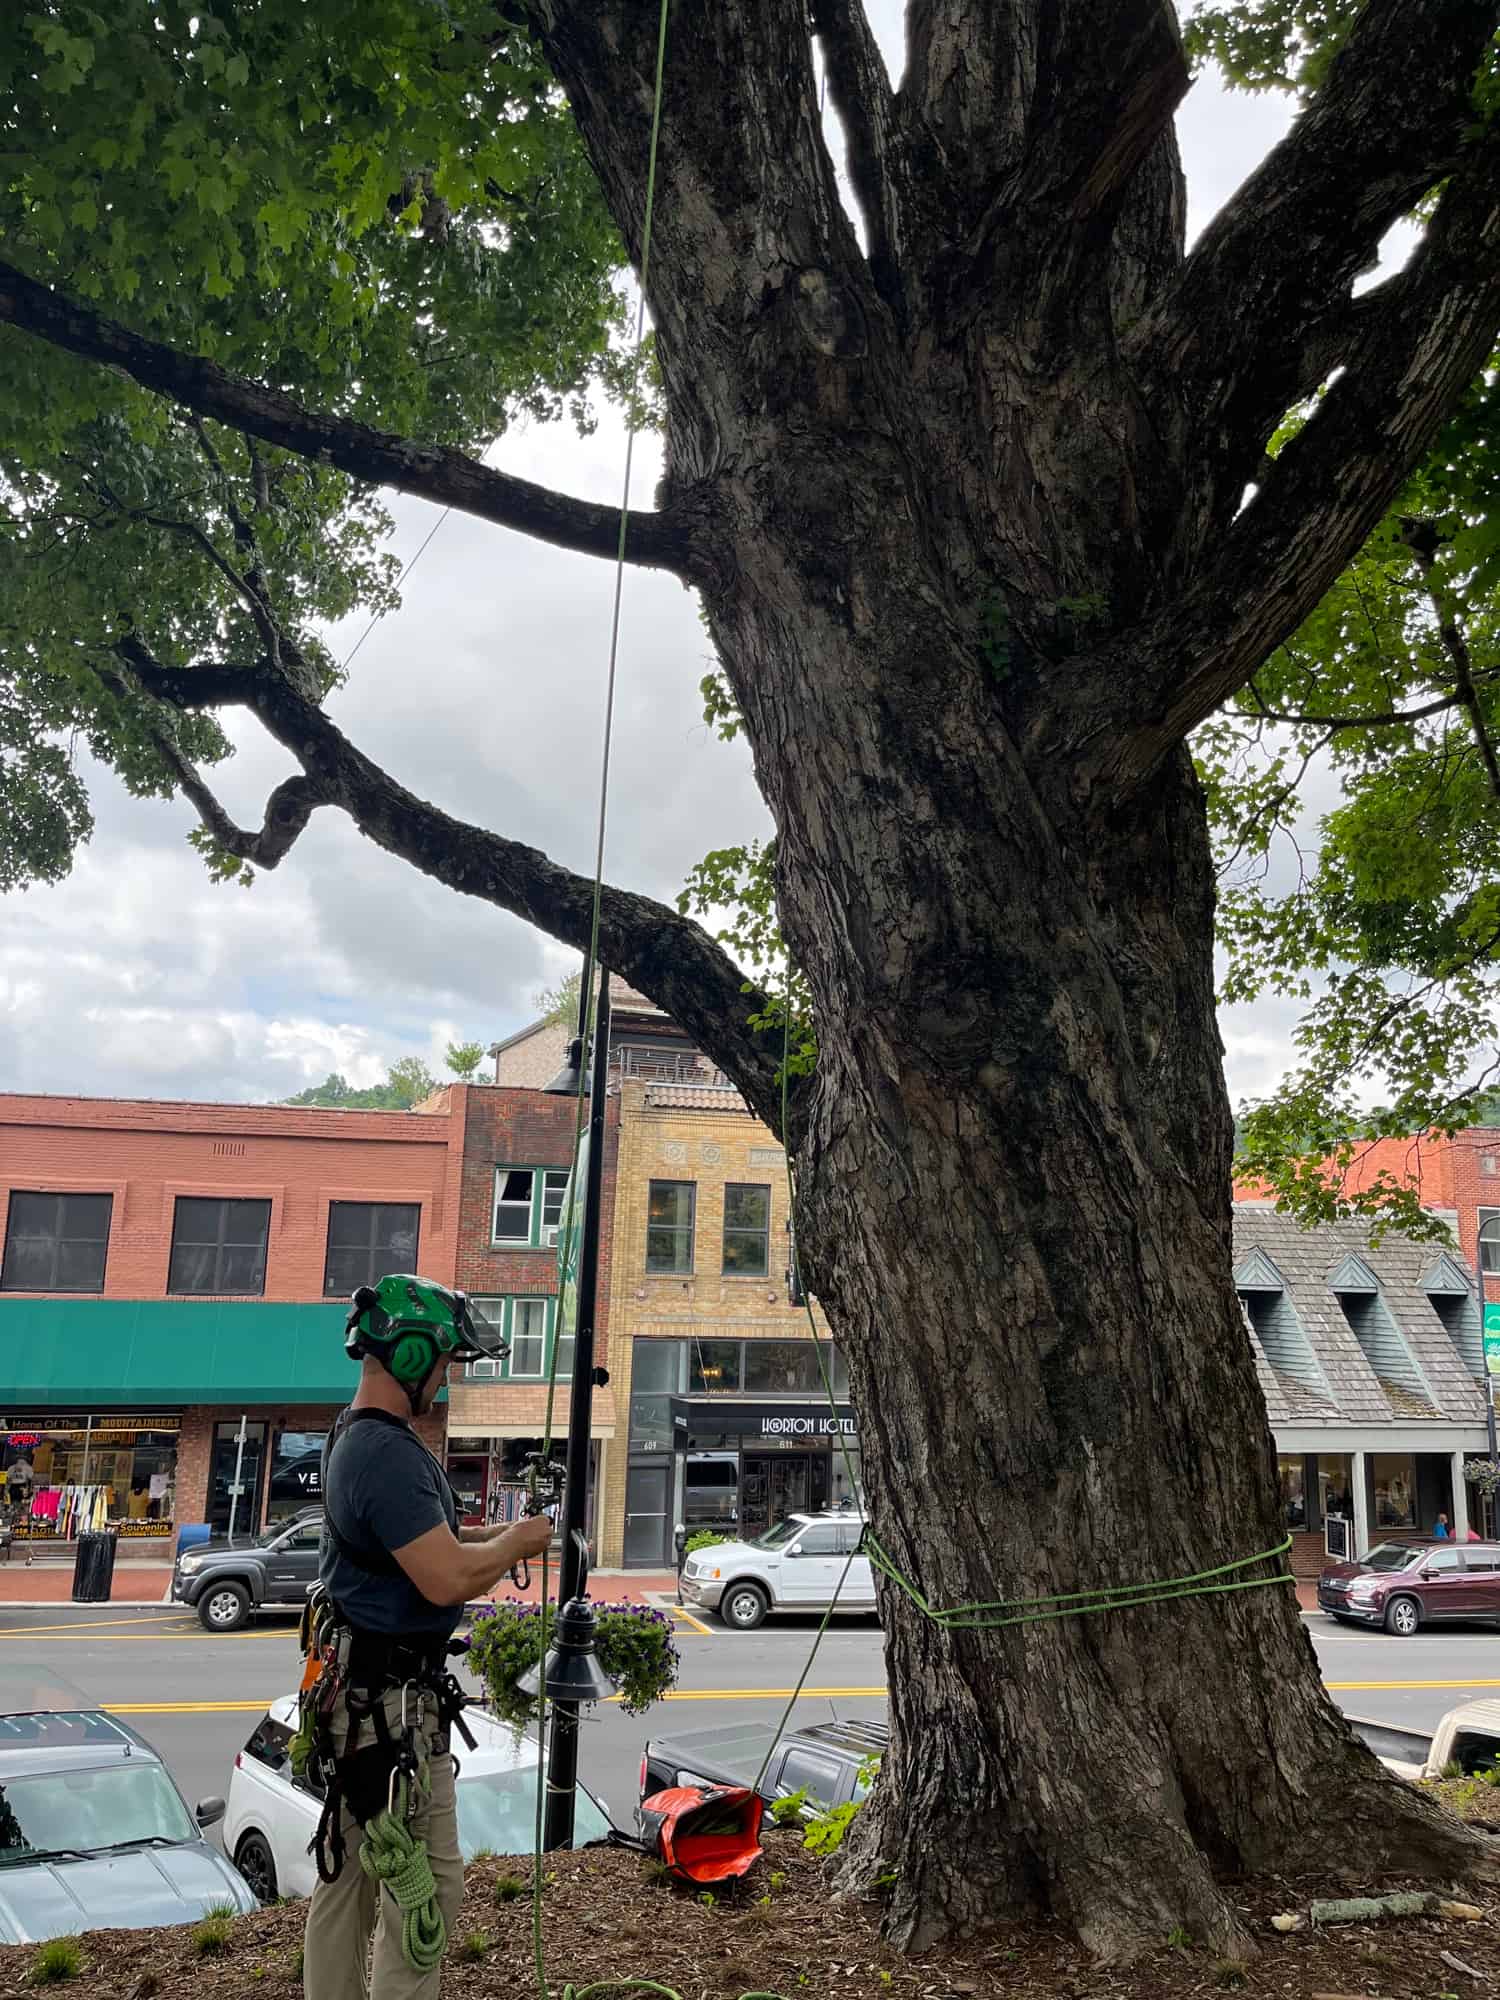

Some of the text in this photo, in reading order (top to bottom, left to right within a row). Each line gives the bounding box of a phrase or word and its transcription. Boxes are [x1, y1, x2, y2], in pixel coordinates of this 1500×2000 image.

[762, 1418, 857, 1433] HORTON HOTEL
[119, 1523, 169, 1531] Souvenirs
